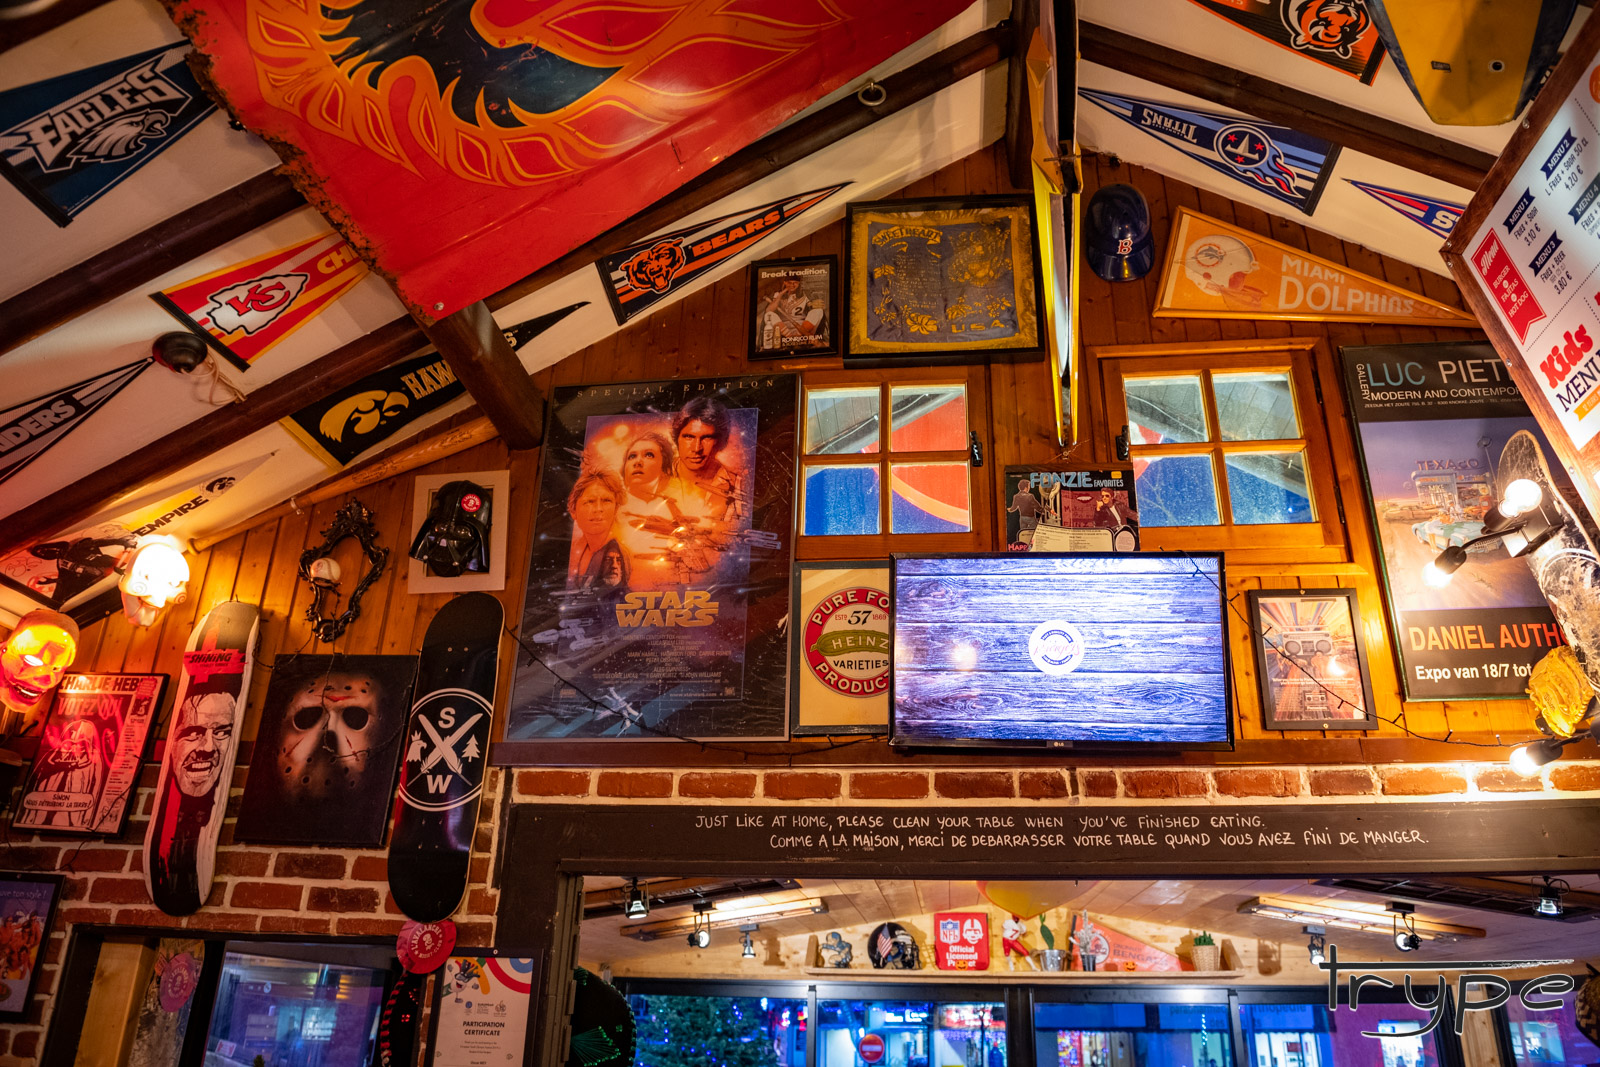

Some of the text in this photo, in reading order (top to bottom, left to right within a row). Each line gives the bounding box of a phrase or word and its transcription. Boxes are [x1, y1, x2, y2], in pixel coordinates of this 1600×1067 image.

[13, 63, 187, 167] EAGLES
[1141, 107, 1198, 145] TITANS
[1547, 139, 1570, 170] MENU 2
[1573, 143, 1583, 157] 50
[1576, 190, 1594, 215] MENU
[1508, 202, 1525, 225] MENU
[692, 210, 782, 258] BEARS
[872, 225, 942, 247] SWEETHEART
[1117, 237, 1133, 255] B
[1534, 240, 1556, 268] MENU 3
[761, 267, 828, 279] Break tradition.
[1281, 254, 1345, 284] MIAMI
[1493, 265, 1511, 289] BURGER
[226, 281, 291, 317] KC
[1278, 275, 1415, 315] DOLPHINS
[1508, 291, 1529, 318] HOT DOG
[794, 306, 803, 316] 2
[1539, 323, 1594, 390] Kids
[576, 379, 775, 398] SPECIAL EDITION
[1355, 363, 1371, 401] GALLERY
[1366, 361, 1426, 387] LUC
[1371, 390, 1422, 401] MODERN
[1424, 389, 1448, 399] AND
[1415, 458, 1479, 471] TEXACO
[1030, 471, 1093, 489] FONZIE
[1093, 479, 1124, 488] FAVORITES
[131, 495, 210, 536] EMPIRE
[616, 590, 720, 609] STAR
[811, 590, 858, 626] PURE
[616, 609, 720, 627] WARS
[847, 610, 872, 626] 57
[832, 636, 889, 650] HEINZ
[1408, 625, 1495, 651] DANIEL
[833, 659, 889, 671] VARIETIES
[1415, 663, 1532, 683] Expo van 18/7 tot
[438, 707, 456, 729] S
[426, 774, 453, 795] W
[695, 815, 729, 828] JUST
[772, 815, 787, 827] AT
[792, 815, 833, 832] HOME,
[836, 815, 885, 828] PLEASE
[893, 815, 930, 829] CLEAN
[937, 815, 971, 832] YOUR
[976, 815, 1015, 828] TABLE
[1025, 816, 1064, 829] WHEN
[1079, 815, 1128, 832] YOU'VE
[770, 834, 813, 849] COMME
[832, 834, 848, 847] LA
[951, 834, 967, 848] DE
[971, 833, 1065, 848] DEBARRASSER
[1073, 833, 1112, 847] VOTRE
[1116, 833, 1157, 847] TABLE
[1165, 834, 1211, 849] QUAND
[1219, 832, 1253, 846] VOUS
[1258, 832, 1295, 847] AVEZ
[1338, 832, 1357, 845] DE
[1363, 829, 1430, 845] MANGER.
[942, 929, 958, 941] NFL
[1009, 928, 1019, 939] 7
[945, 952, 978, 960] Licensed
[949, 945, 975, 953] Official
[462, 1020, 506, 1028] PARTICIPATION
[464, 1029, 501, 1037] CERTIFICATE
